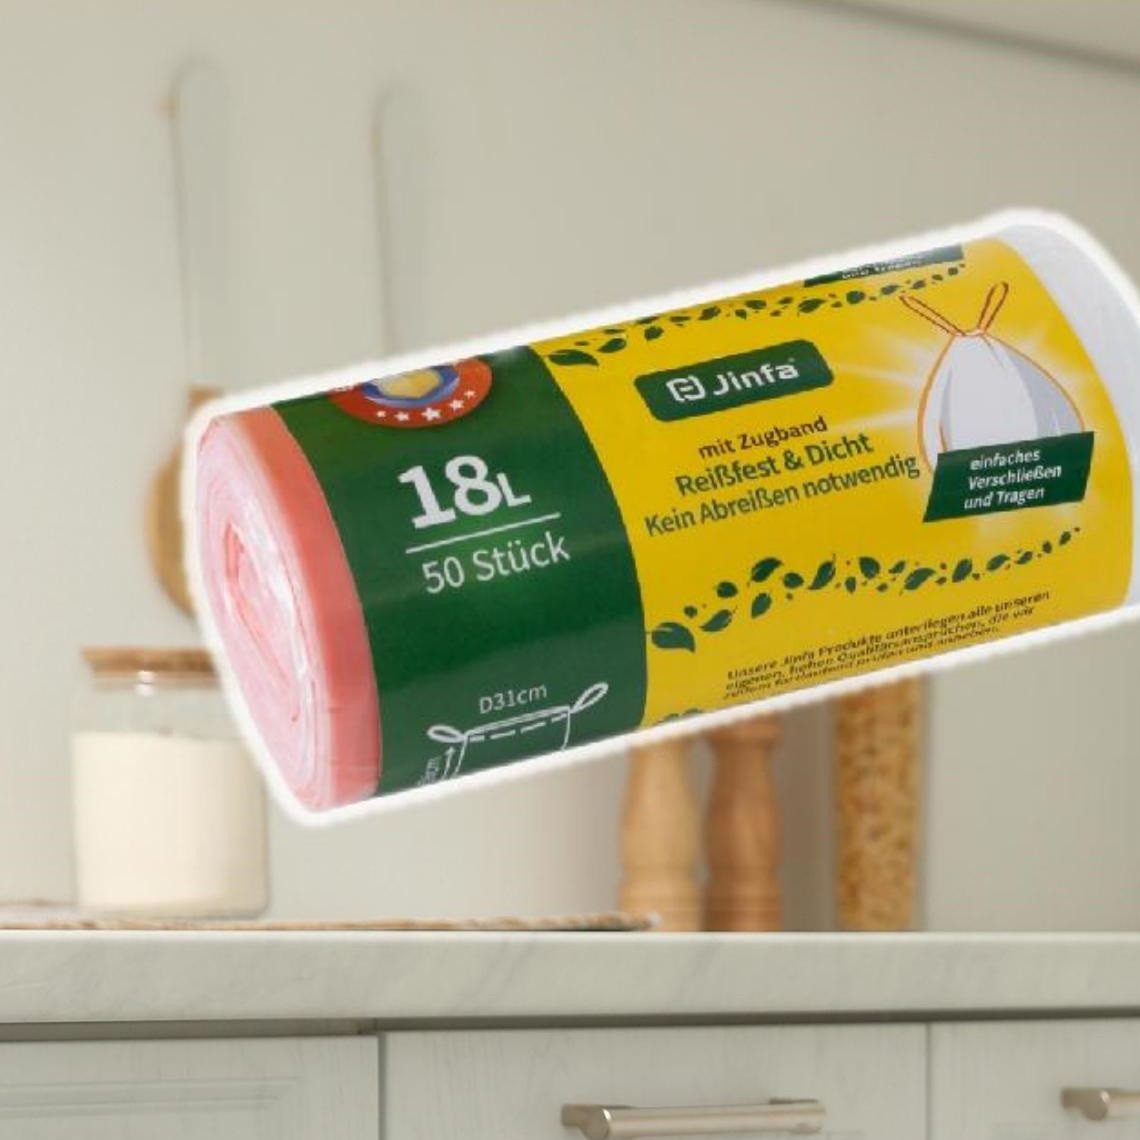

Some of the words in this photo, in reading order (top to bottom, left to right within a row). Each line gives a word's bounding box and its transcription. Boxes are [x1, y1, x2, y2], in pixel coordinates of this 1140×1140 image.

[713, 363, 799, 396] Jinfa
[699, 439, 736, 459] mit
[740, 415, 828, 448] Zugband
[675, 455, 780, 496] Reißfest
[784, 450, 804, 471] &
[805, 432, 874, 466] Dicht
[968, 465, 1062, 490] Verschließen
[970, 450, 1040, 471] einfaches
[398, 454, 532, 529] 18L
[644, 509, 697, 537] Kein
[700, 484, 799, 524] Abreißen
[803, 454, 921, 499] notwendig
[964, 492, 994, 509] und
[997, 487, 1045, 505] Tragen
[422, 556, 465, 593] 50
[473, 531, 571, 581] Stück
[479, 684, 547, 714] D31cm
